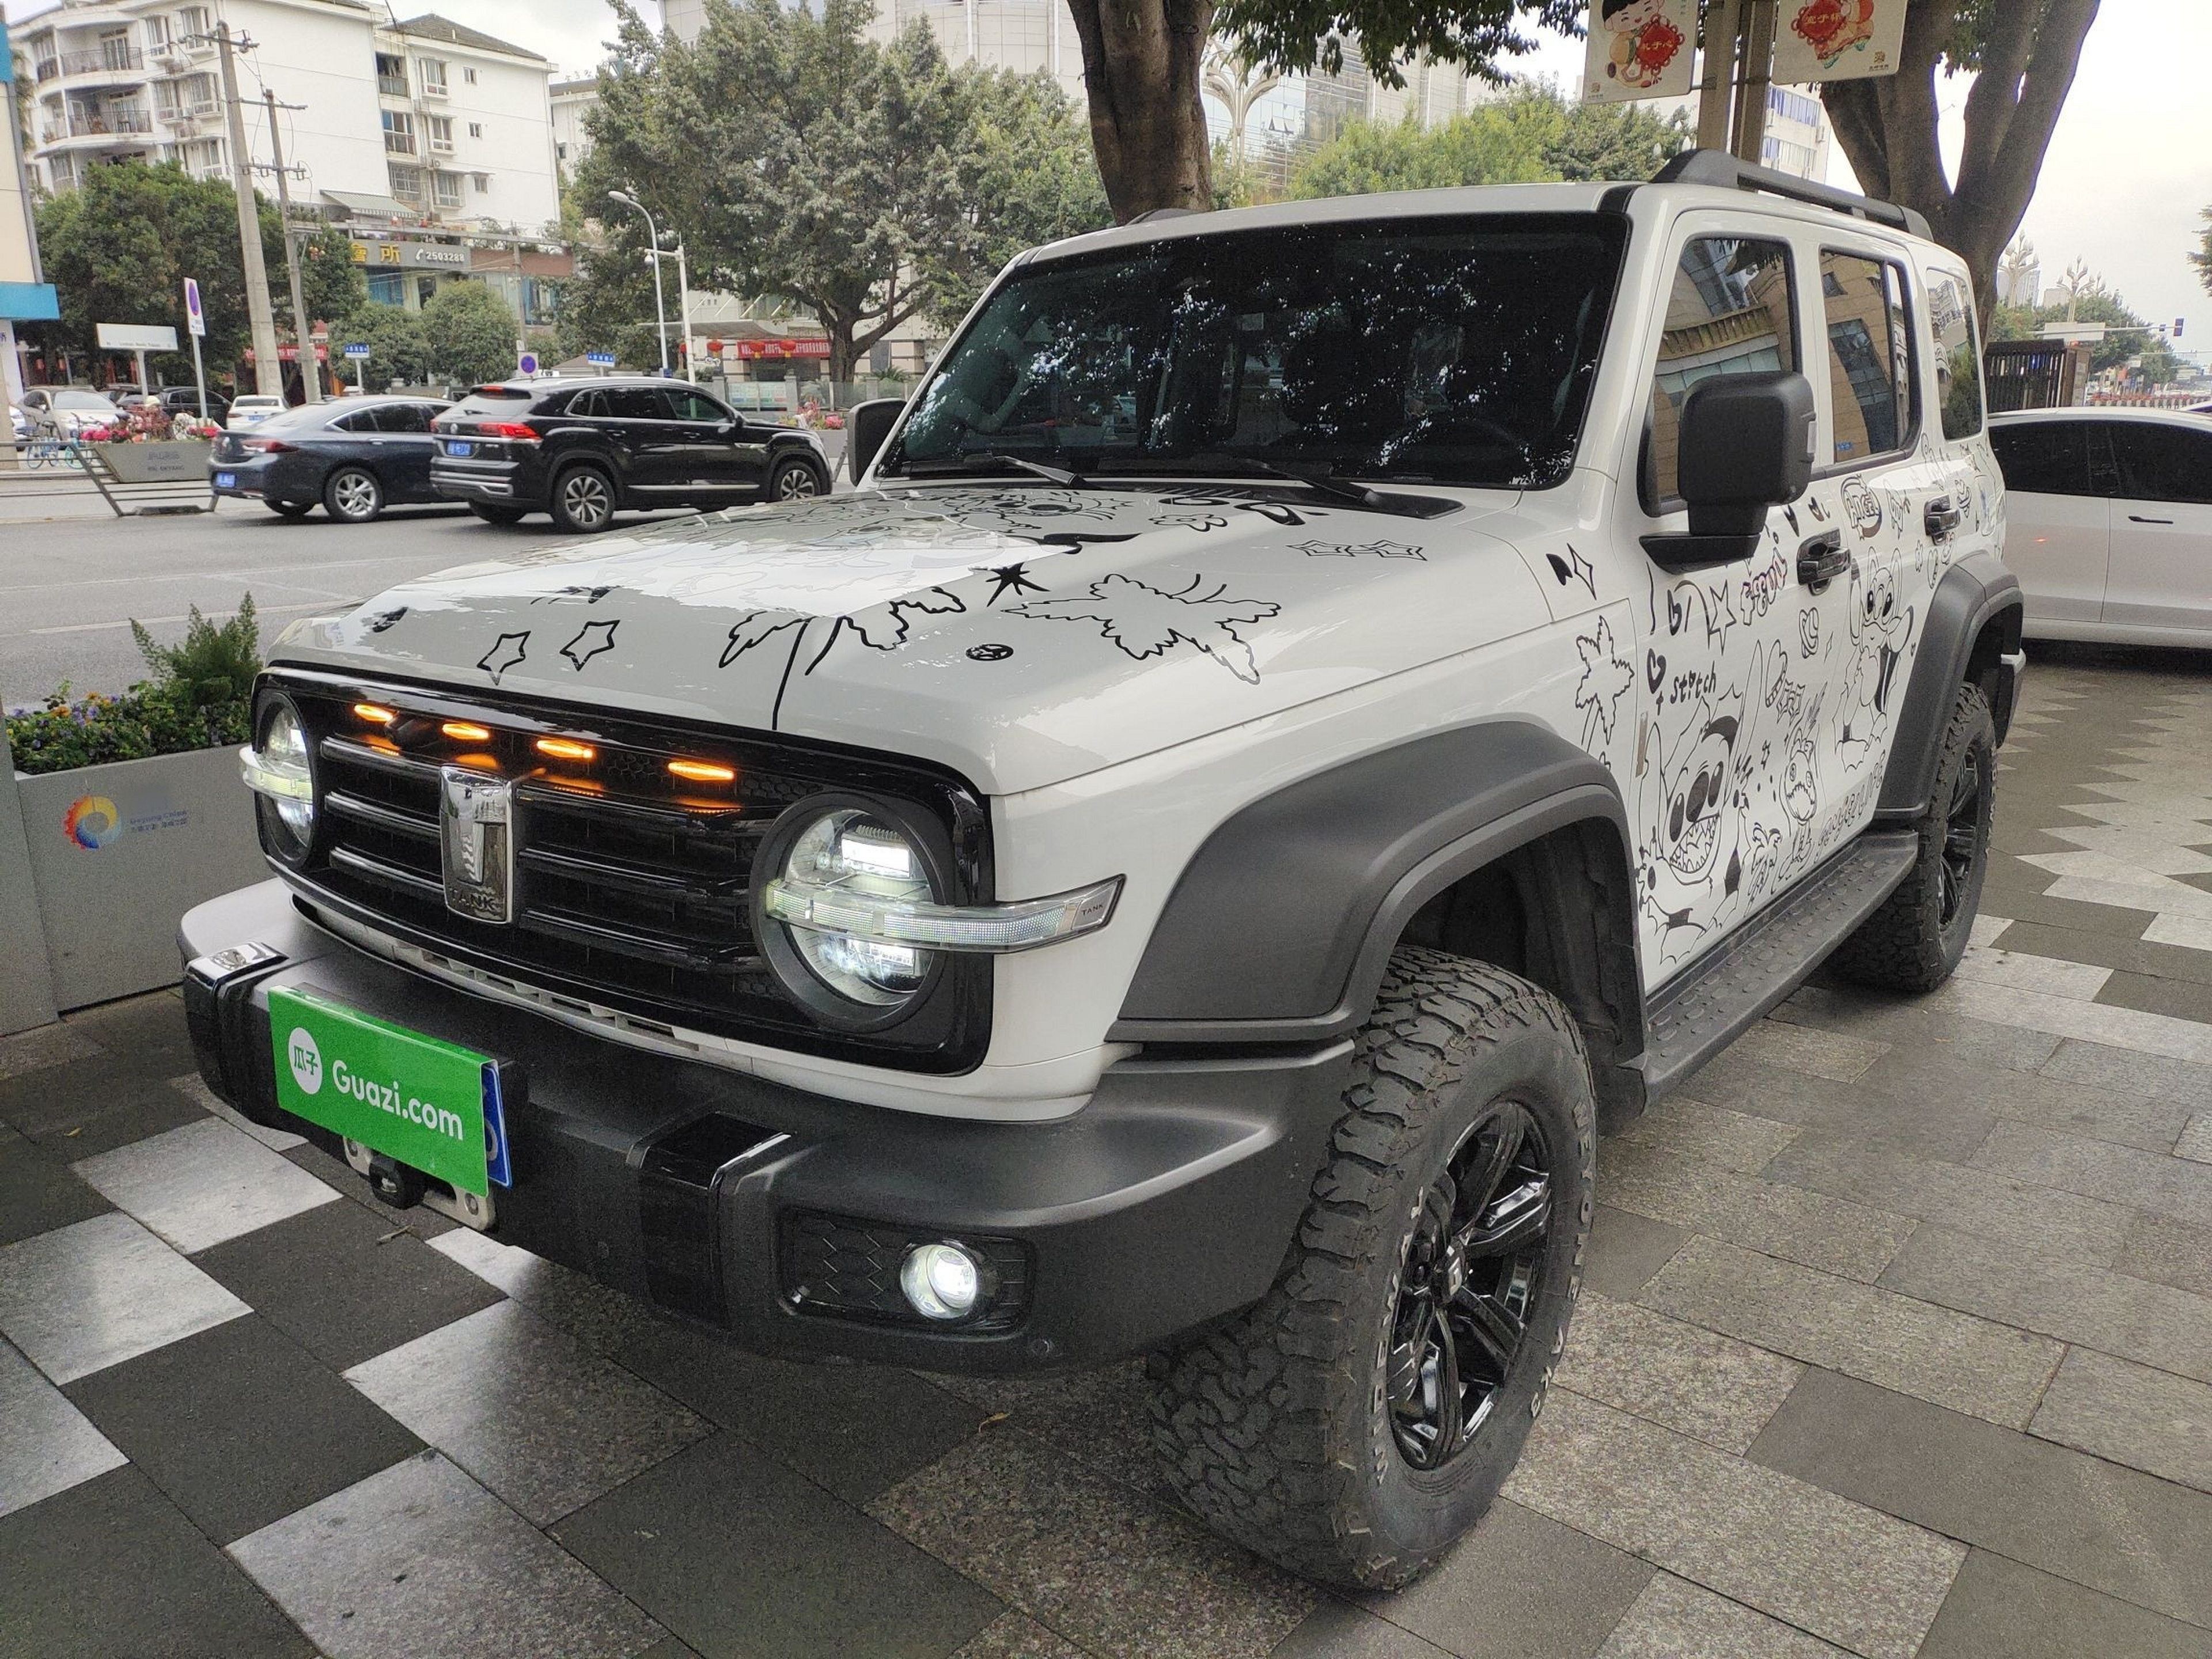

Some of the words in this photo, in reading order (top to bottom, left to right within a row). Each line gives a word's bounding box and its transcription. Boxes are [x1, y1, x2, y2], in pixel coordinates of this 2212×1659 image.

[449, 888, 501, 915] TANK
[1082, 904, 1103, 915] TANK
[294, 1045, 319, 1076] 瓜子
[332, 1059, 464, 1141] Guazi.com
